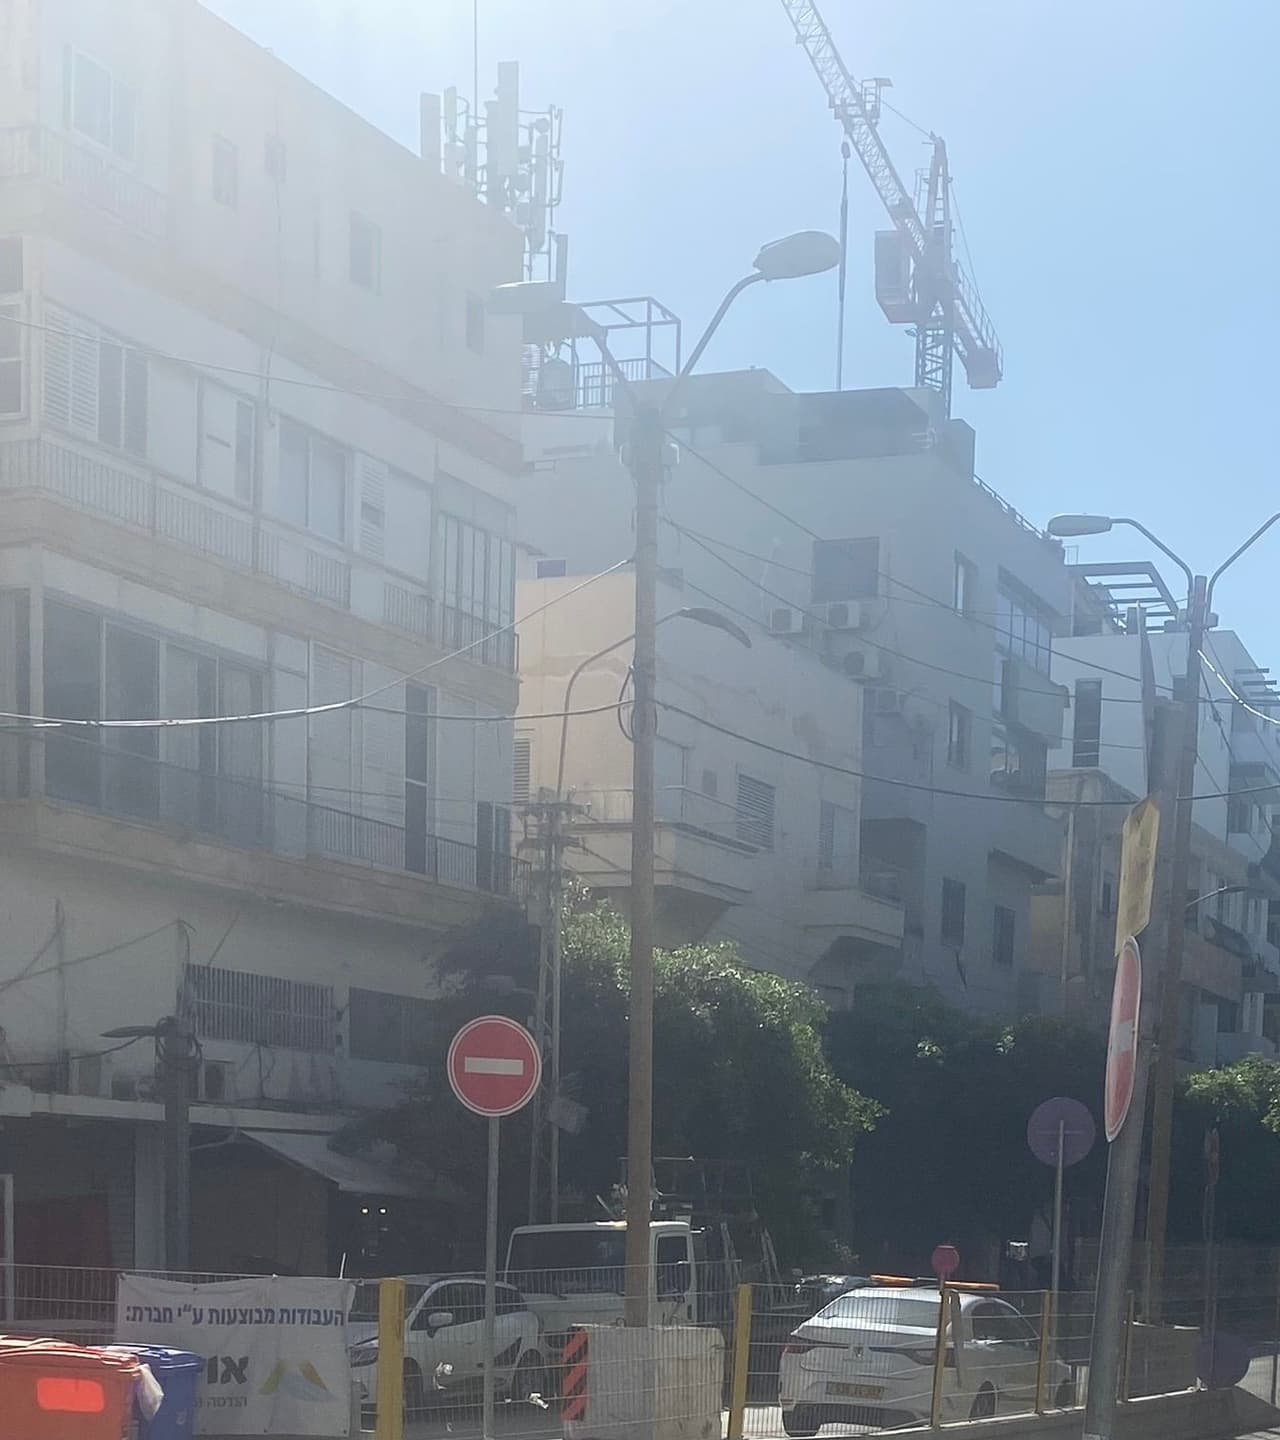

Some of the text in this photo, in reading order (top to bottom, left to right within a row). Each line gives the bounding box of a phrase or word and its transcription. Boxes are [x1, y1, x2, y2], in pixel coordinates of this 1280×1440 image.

[126, 1305, 173, 1324] חברת:
[207, 1306, 275, 1325] מבוצעות
[278, 1307, 345, 1326] העבודות
